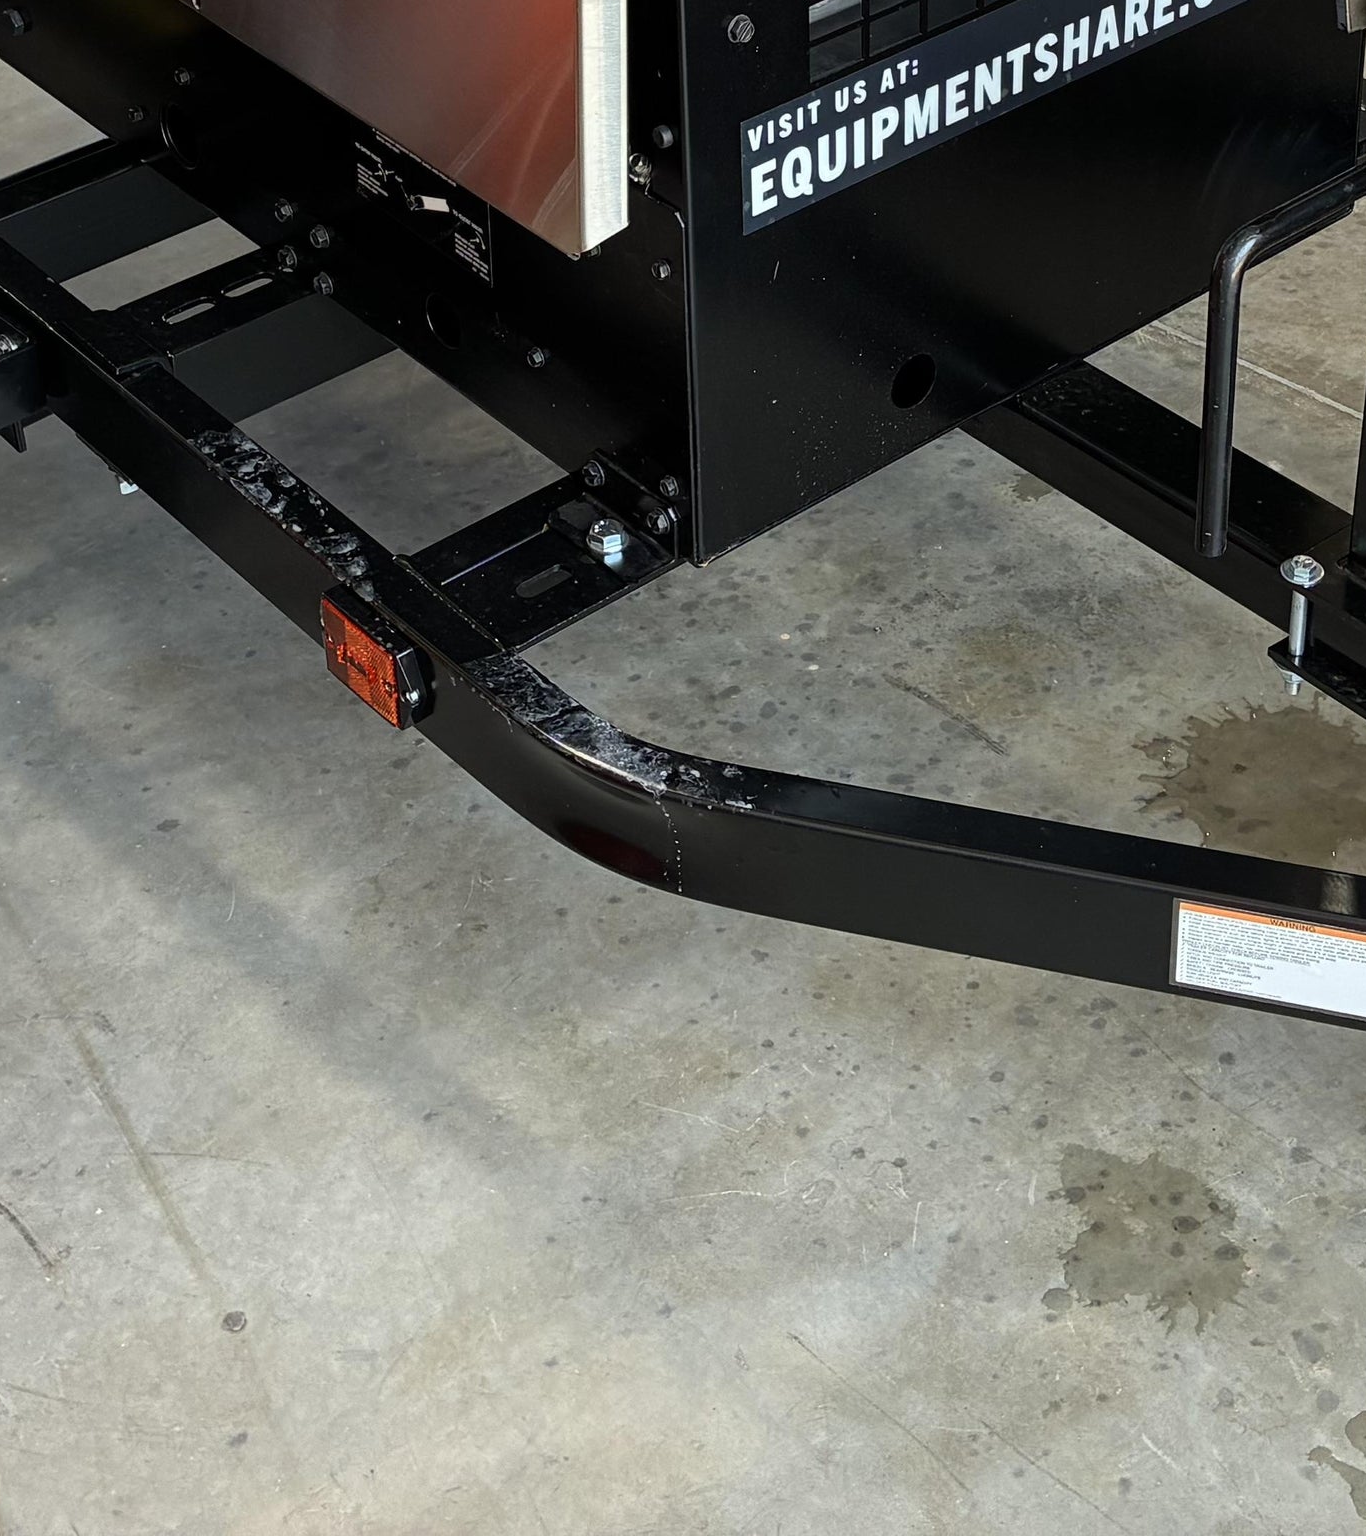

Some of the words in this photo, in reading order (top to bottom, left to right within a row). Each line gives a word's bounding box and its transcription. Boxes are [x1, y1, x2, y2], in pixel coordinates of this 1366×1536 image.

[747, 99, 821, 152] VISIT
[835, 80, 867, 114] US
[879, 58, 919, 94] AT:
[1269, 918, 1317, 934] WARNING
